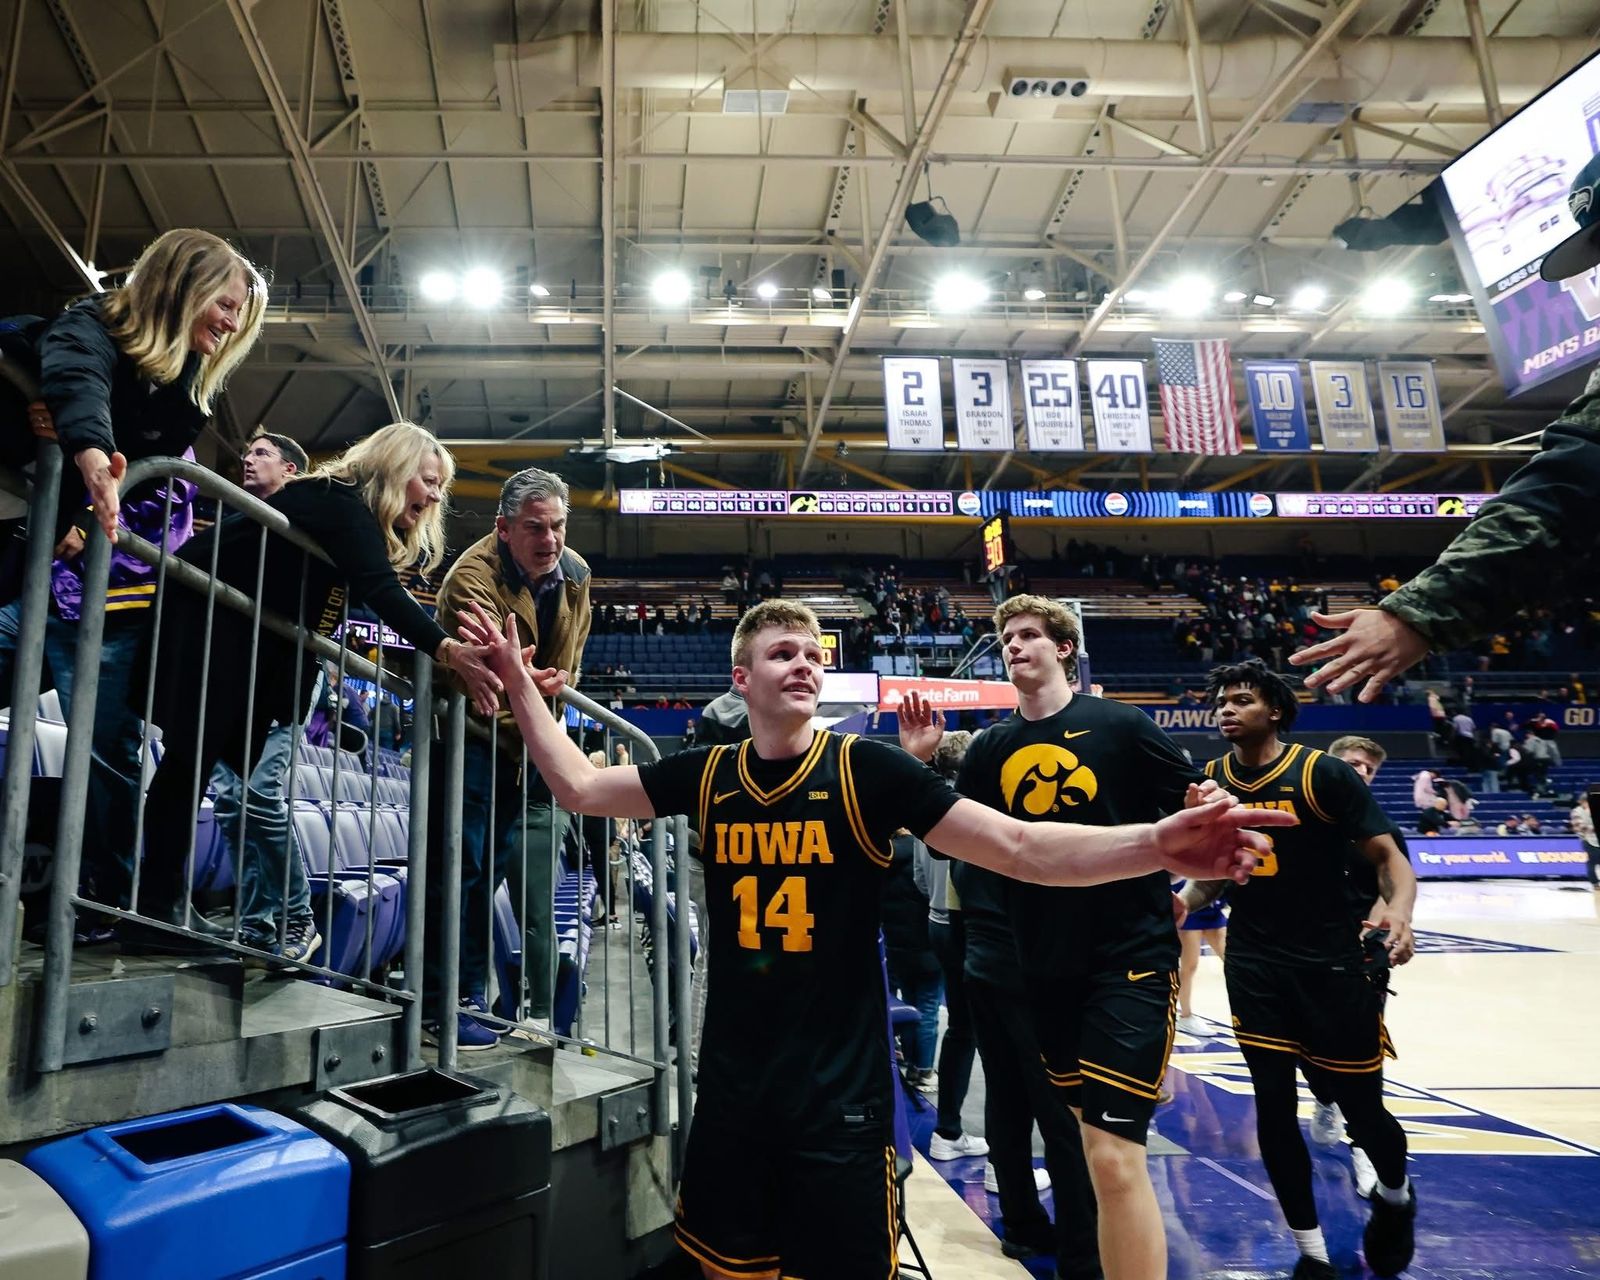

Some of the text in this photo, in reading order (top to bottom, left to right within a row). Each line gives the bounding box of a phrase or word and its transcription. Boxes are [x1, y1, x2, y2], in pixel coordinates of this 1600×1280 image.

[1522, 335, 1580, 375] MEN'S
[903, 371, 924, 405] 2
[971, 371, 993, 406] 3
[1028, 373, 1072, 407] 25
[1096, 374, 1141, 408] 40
[1255, 372, 1295, 410] 10
[1330, 374, 1353, 409] 3
[1391, 374, 1426, 409] 16
[900, 419, 932, 427] THOMAS
[722, 501, 734, 511] 14
[739, 501, 751, 511] 12
[775, 501, 782, 511] 1
[986, 535, 1004, 570] 30
[328, 587, 344, 606] GO
[355, 626, 369, 638] 74
[906, 687, 979, 703] Sate Farm
[1565, 708, 1594, 726] GO
[714, 820, 834, 865] IOWA
[1418, 852, 1442, 864] For
[732, 875, 815, 952] 14
